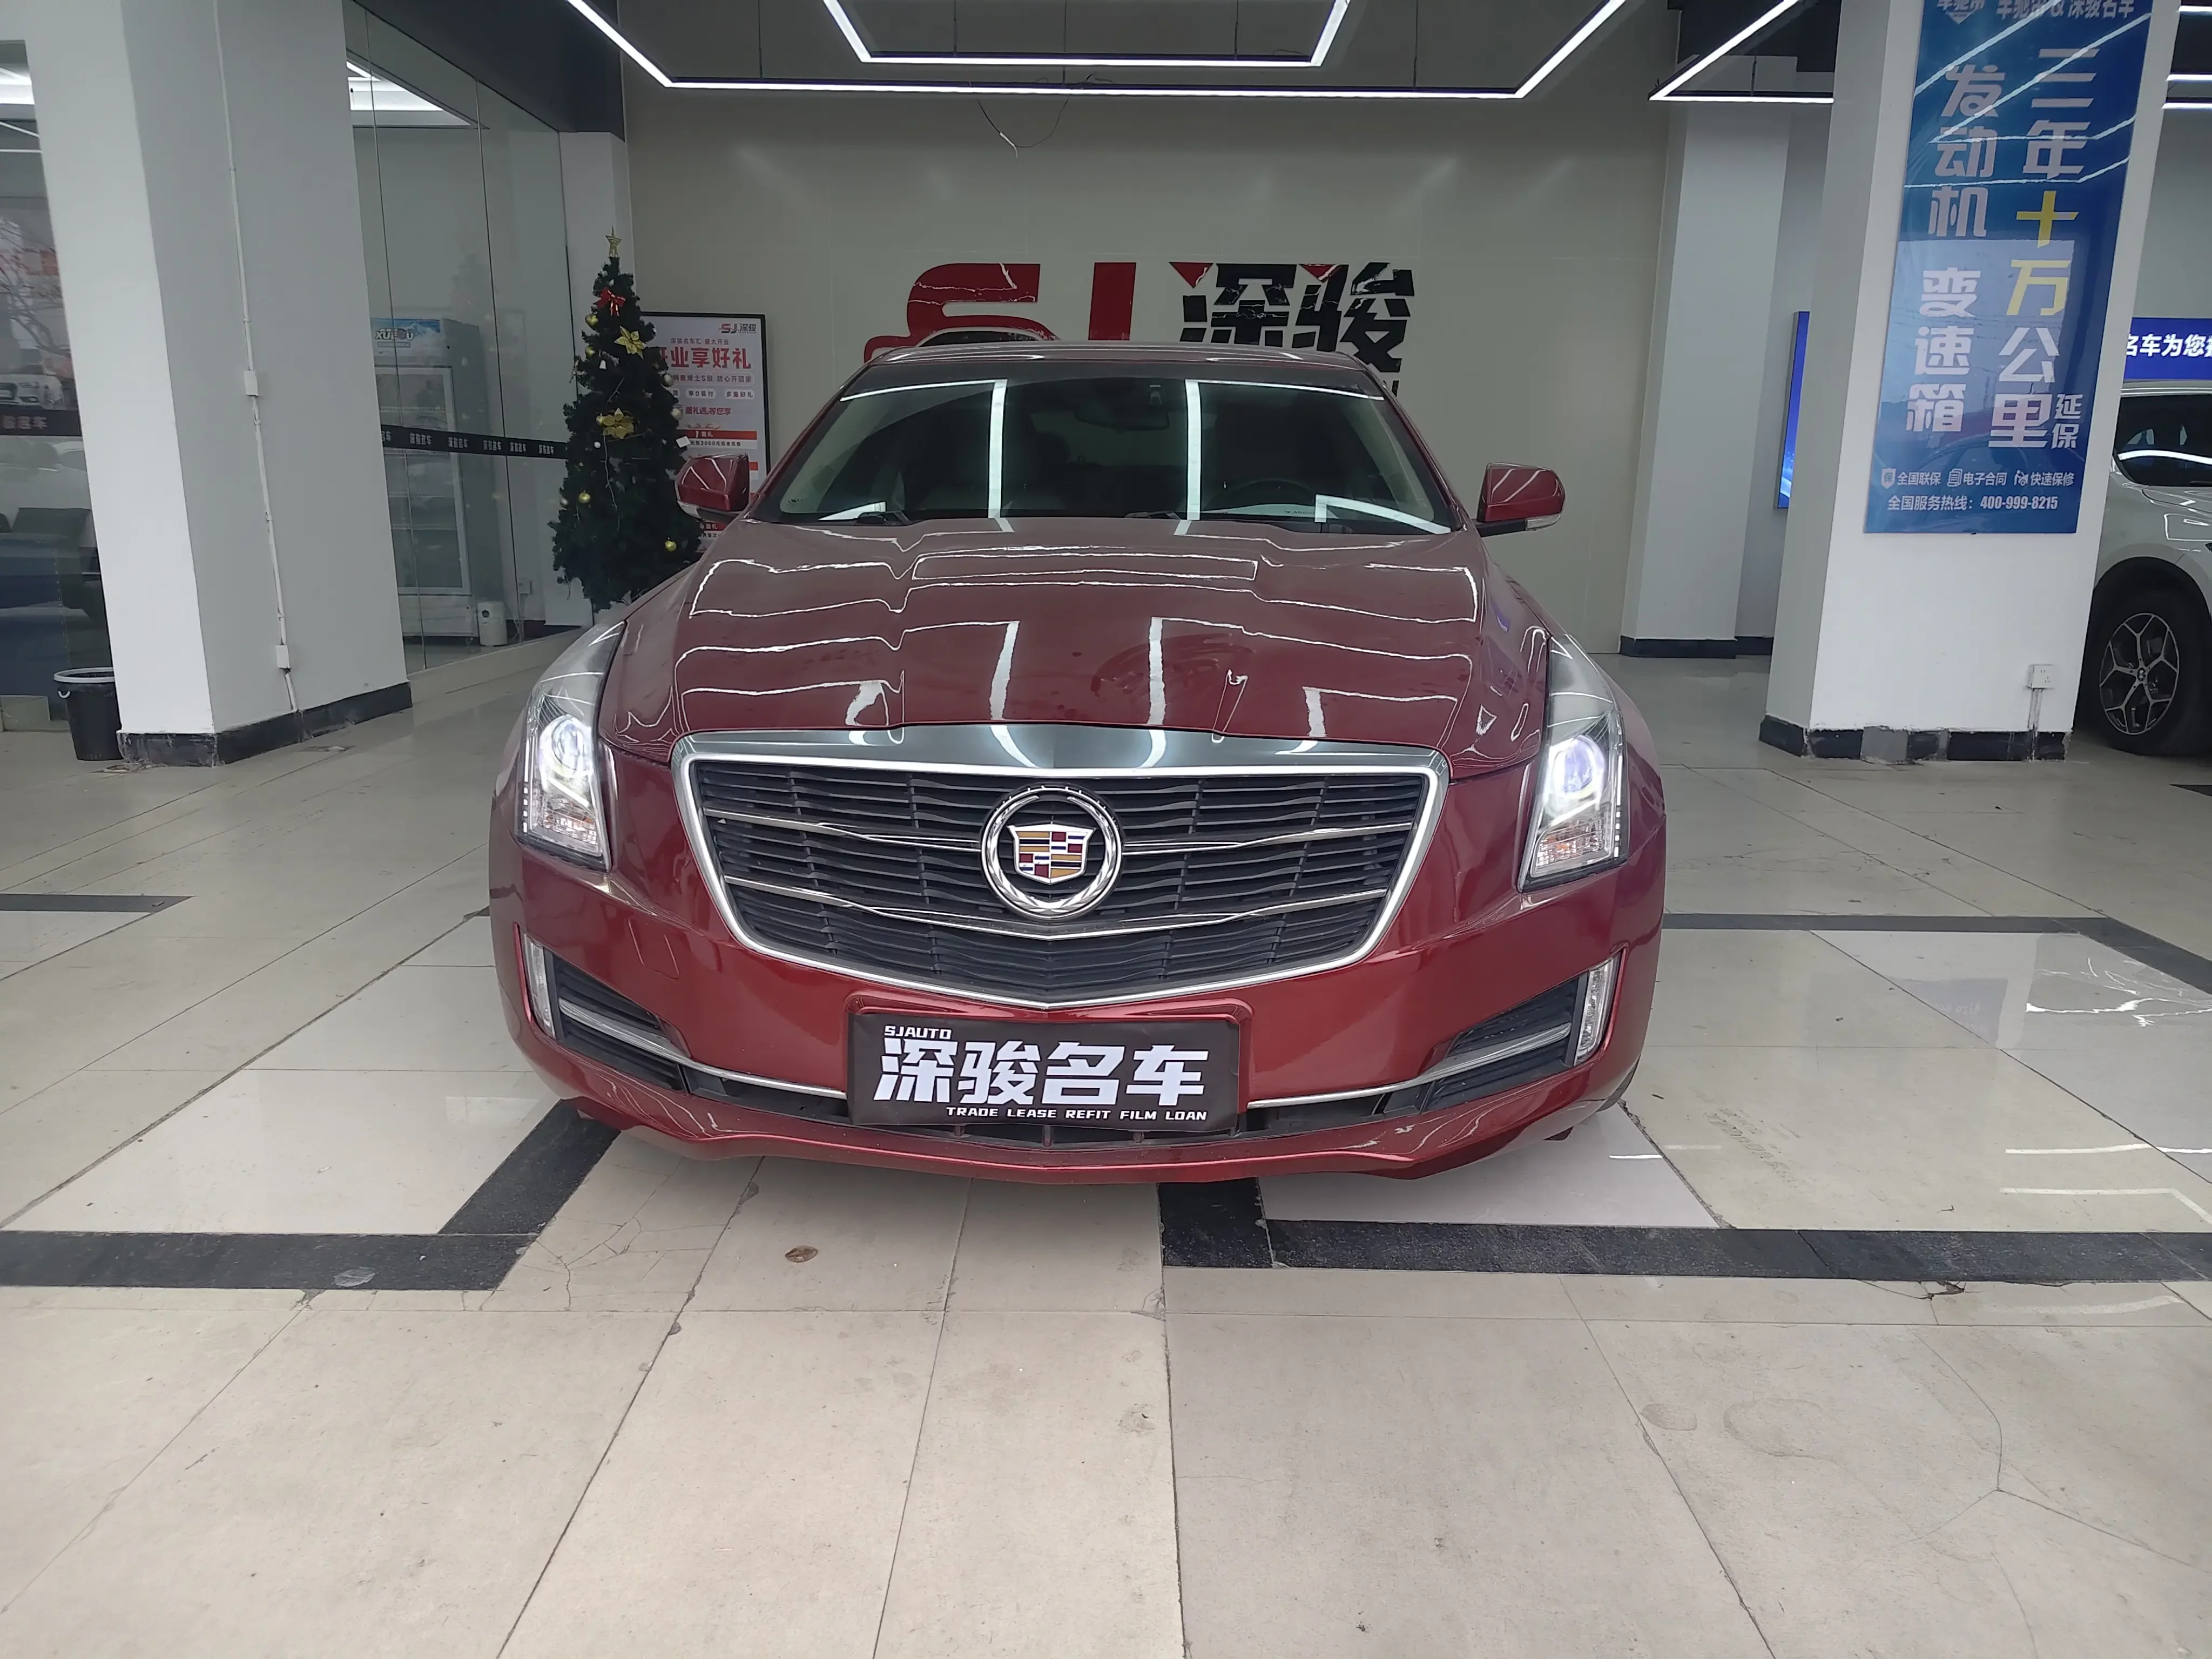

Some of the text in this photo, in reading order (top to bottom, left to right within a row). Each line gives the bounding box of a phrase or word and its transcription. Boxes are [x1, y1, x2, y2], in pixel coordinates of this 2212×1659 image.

[1928, 64, 2006, 237] 发动机
[1988, 48, 2100, 448] 三年十万公里
[1906, 267, 1981, 432] 变速箱
[2051, 394, 2084, 449] 延保
[1897, 472, 1942, 486] 全国联保
[1964, 471, 2007, 486] 电子合同
[2031, 471, 2075, 487] 快速保修
[884, 1026, 952, 1039] SJAUTO
[873, 1038, 1209, 1106] 深骏名车
[946, 1107, 1208, 1121] TRADE LEASE REFIT FILM LOAN
